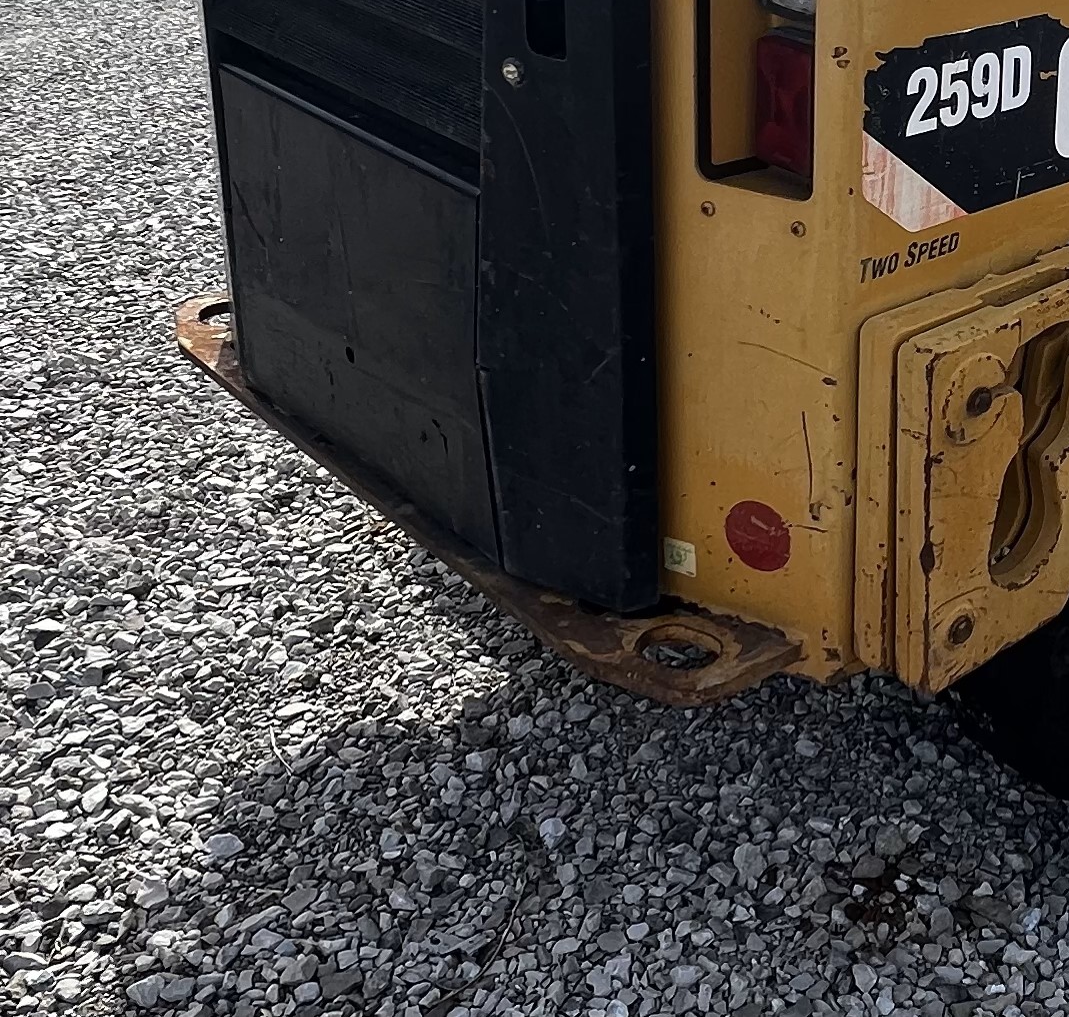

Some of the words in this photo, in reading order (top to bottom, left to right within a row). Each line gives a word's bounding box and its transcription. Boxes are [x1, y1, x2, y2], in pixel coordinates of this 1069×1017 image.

[905, 45, 1032, 138] 259D
[860, 252, 900, 284] TWO
[903, 232, 960, 269] SPEED
